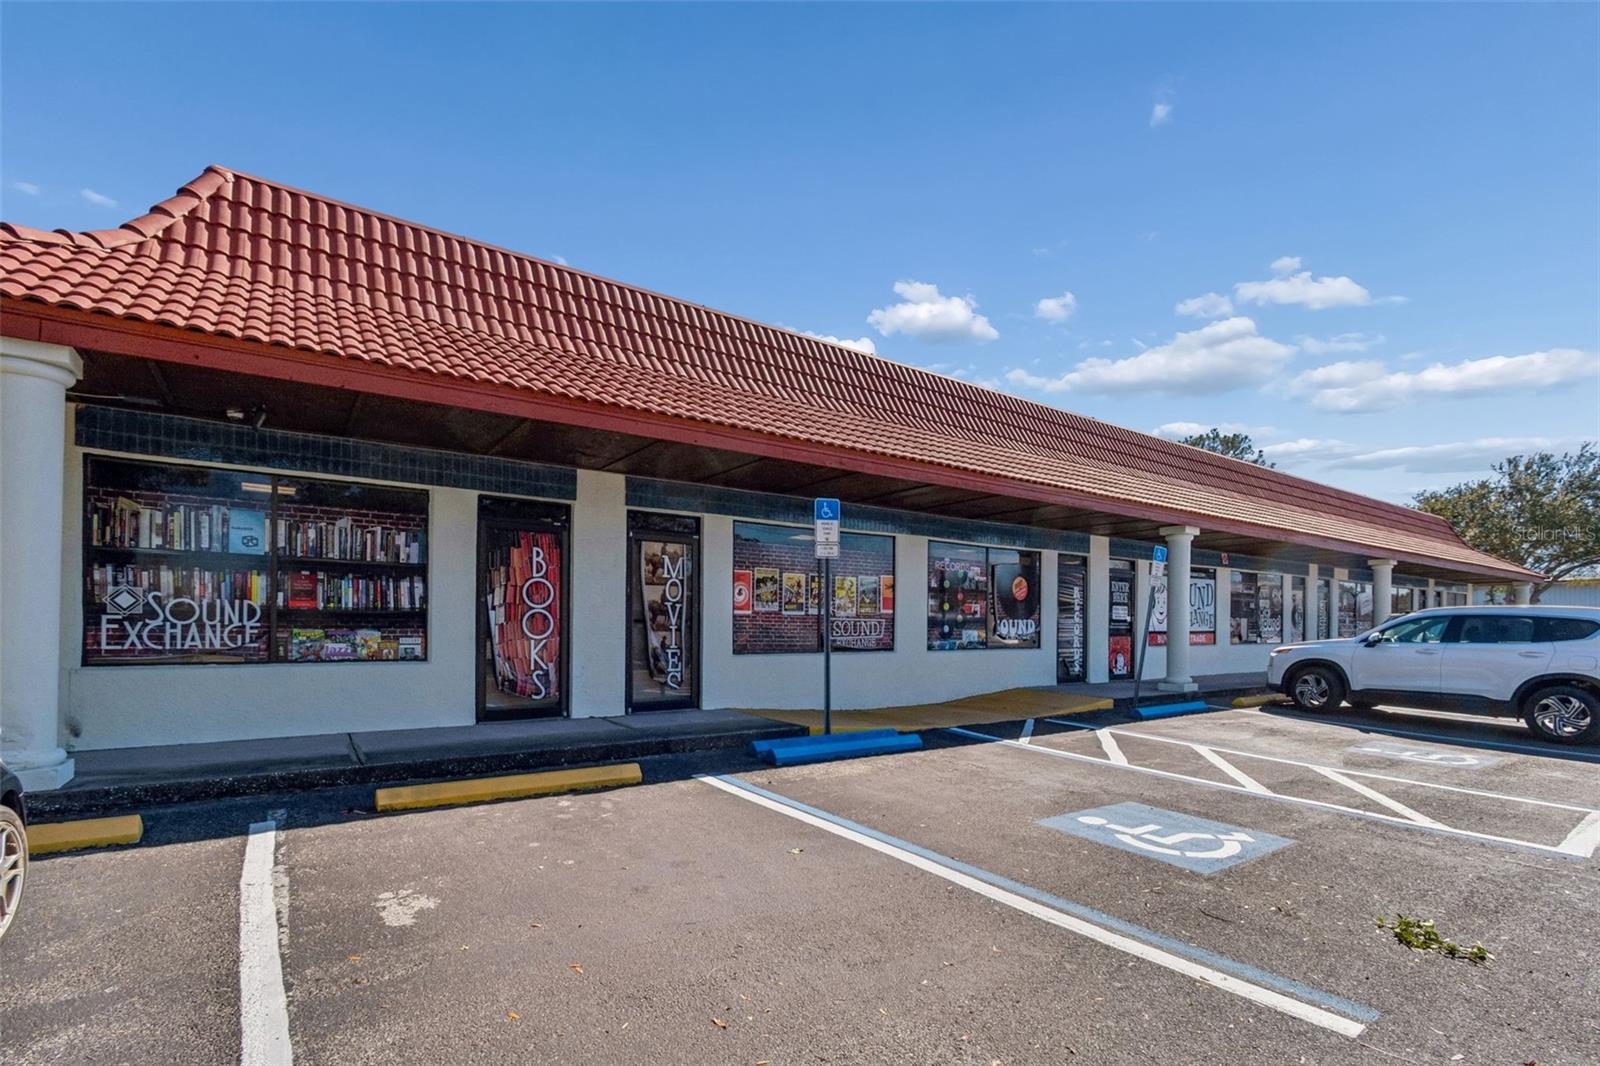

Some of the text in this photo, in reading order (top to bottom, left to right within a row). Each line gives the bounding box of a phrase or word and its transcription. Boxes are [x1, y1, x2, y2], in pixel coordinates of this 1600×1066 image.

[145, 591, 261, 625] SOUND
[1190, 583, 1213, 609] UND
[101, 615, 260, 650] EXCHANGE
[522, 547, 554, 700] BOOKS
[662, 555, 684, 690] MOVIES
[832, 620, 880, 636] SOUND
[1073, 587, 1083, 672] RECORDS
